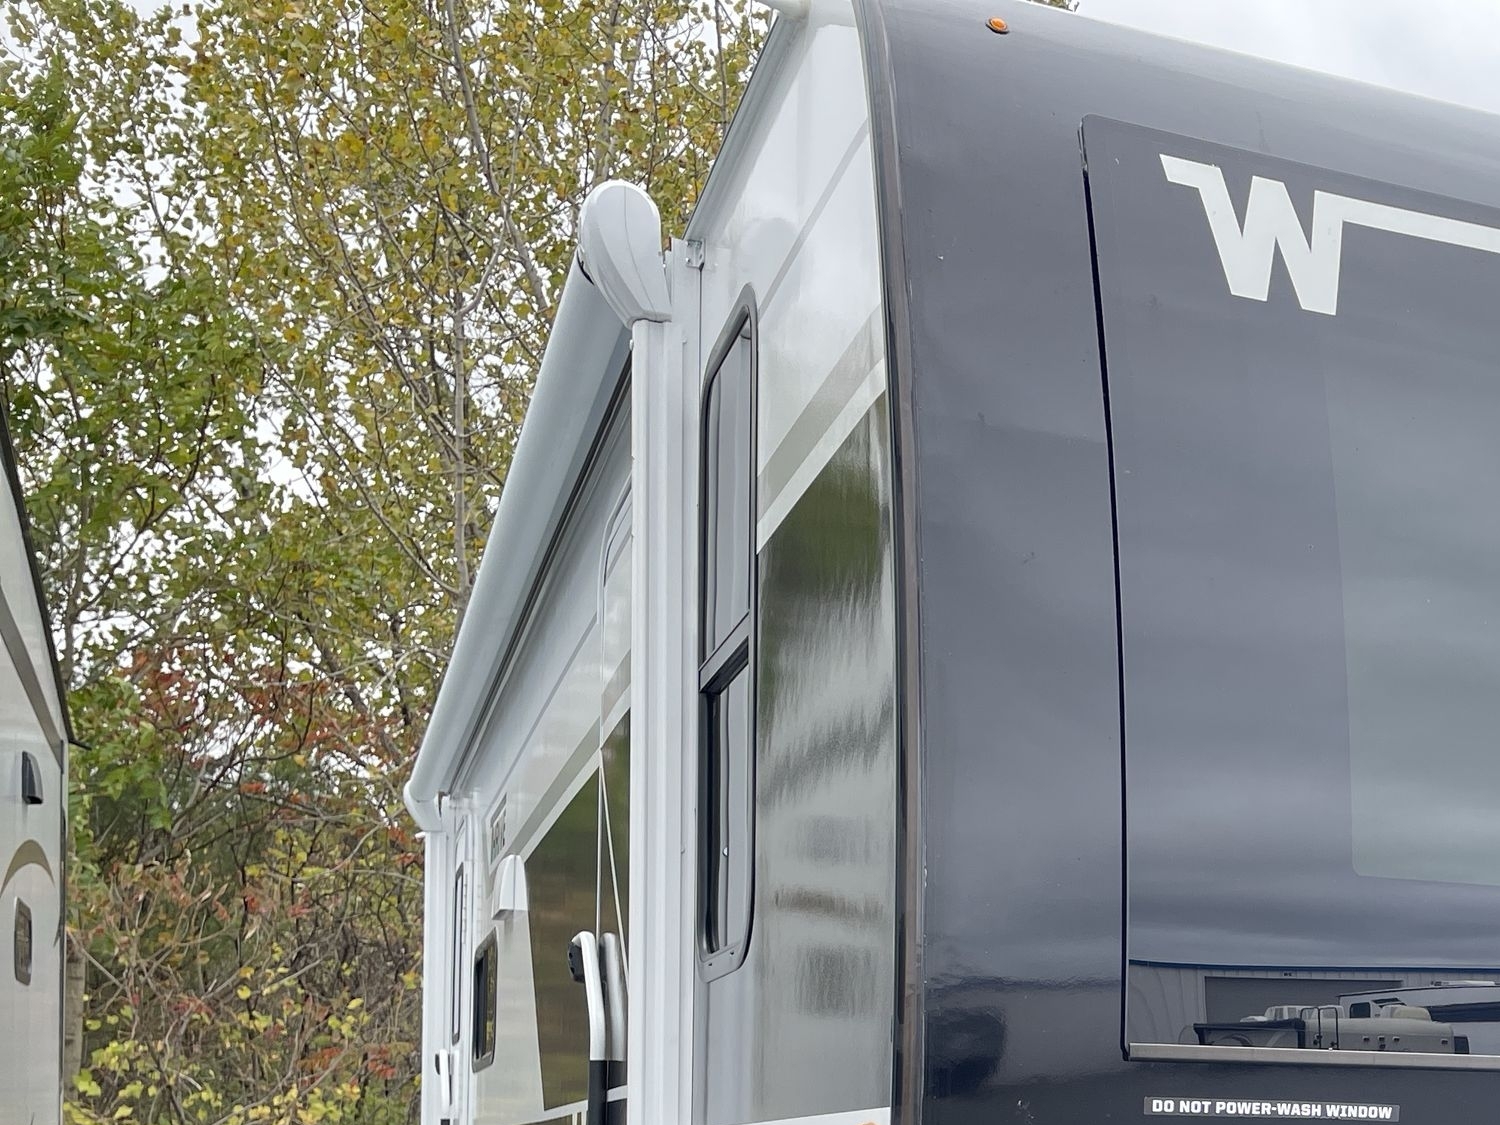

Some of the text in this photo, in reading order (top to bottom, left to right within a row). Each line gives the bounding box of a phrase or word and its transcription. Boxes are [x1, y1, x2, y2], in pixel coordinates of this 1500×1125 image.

[1159, 153, 1344, 316] W
[1152, 1099, 1393, 1120] DO NOT POWER-WASH WINDOW
